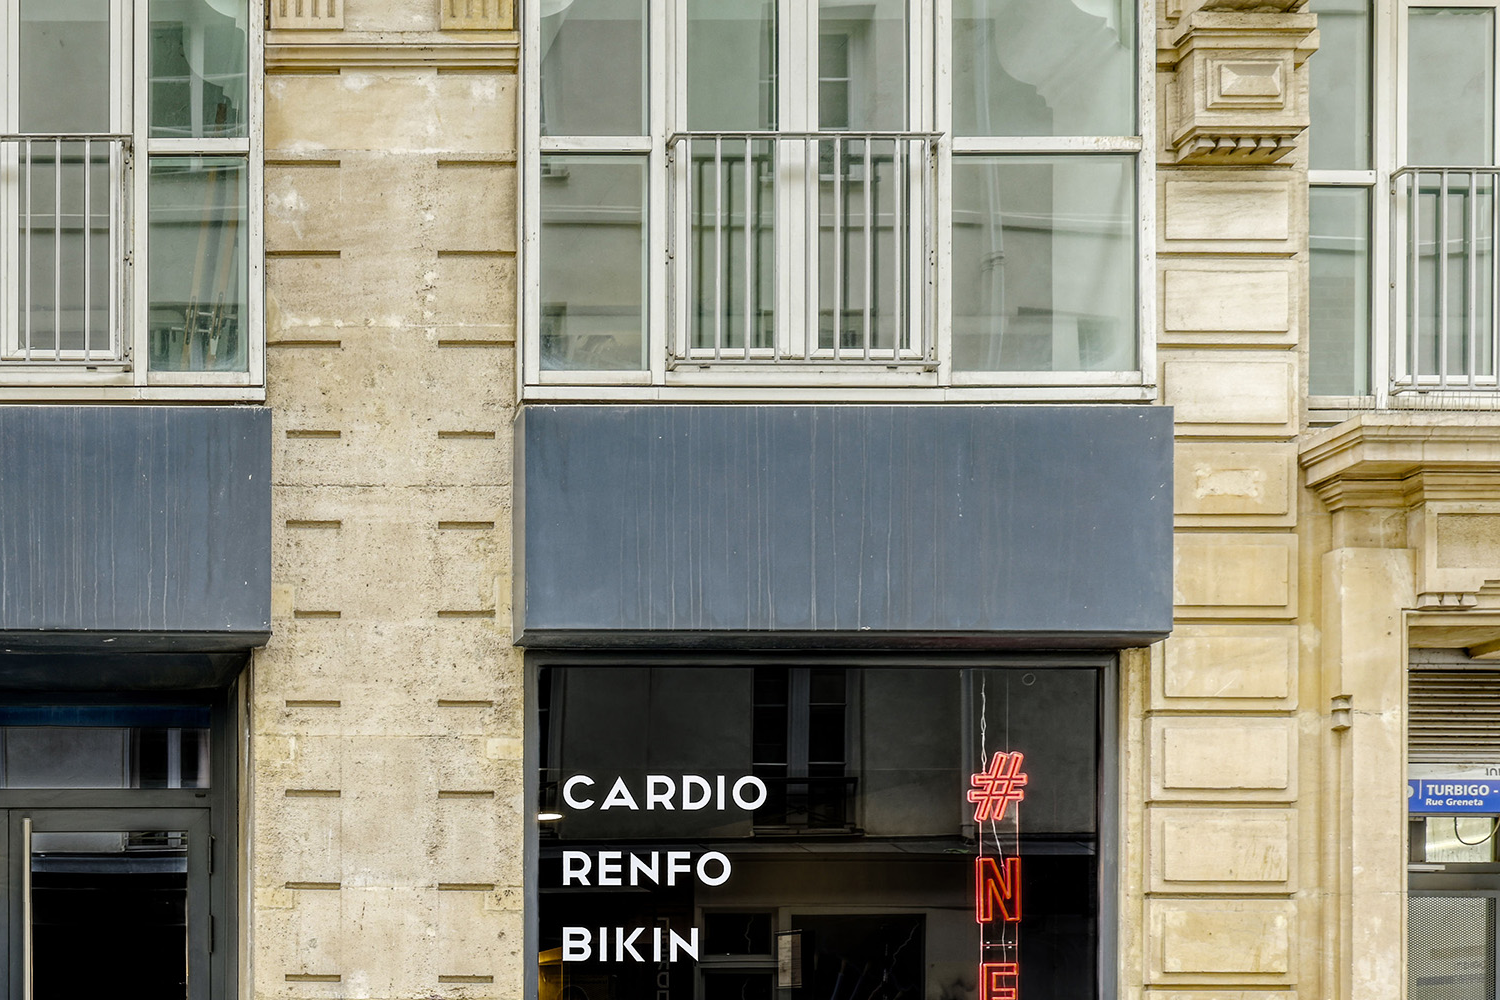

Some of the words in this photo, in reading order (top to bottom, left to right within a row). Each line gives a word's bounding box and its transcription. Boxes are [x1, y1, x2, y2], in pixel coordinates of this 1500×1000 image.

[562, 775, 768, 811] CARDIO
[1425, 798, 1443, 806] Rue
[1445, 798, 1484, 806] Greneta
[1426, 784, 1490, 796] TURBIGO
[562, 851, 732, 886] RENFO
[562, 926, 700, 963] BIKIN
